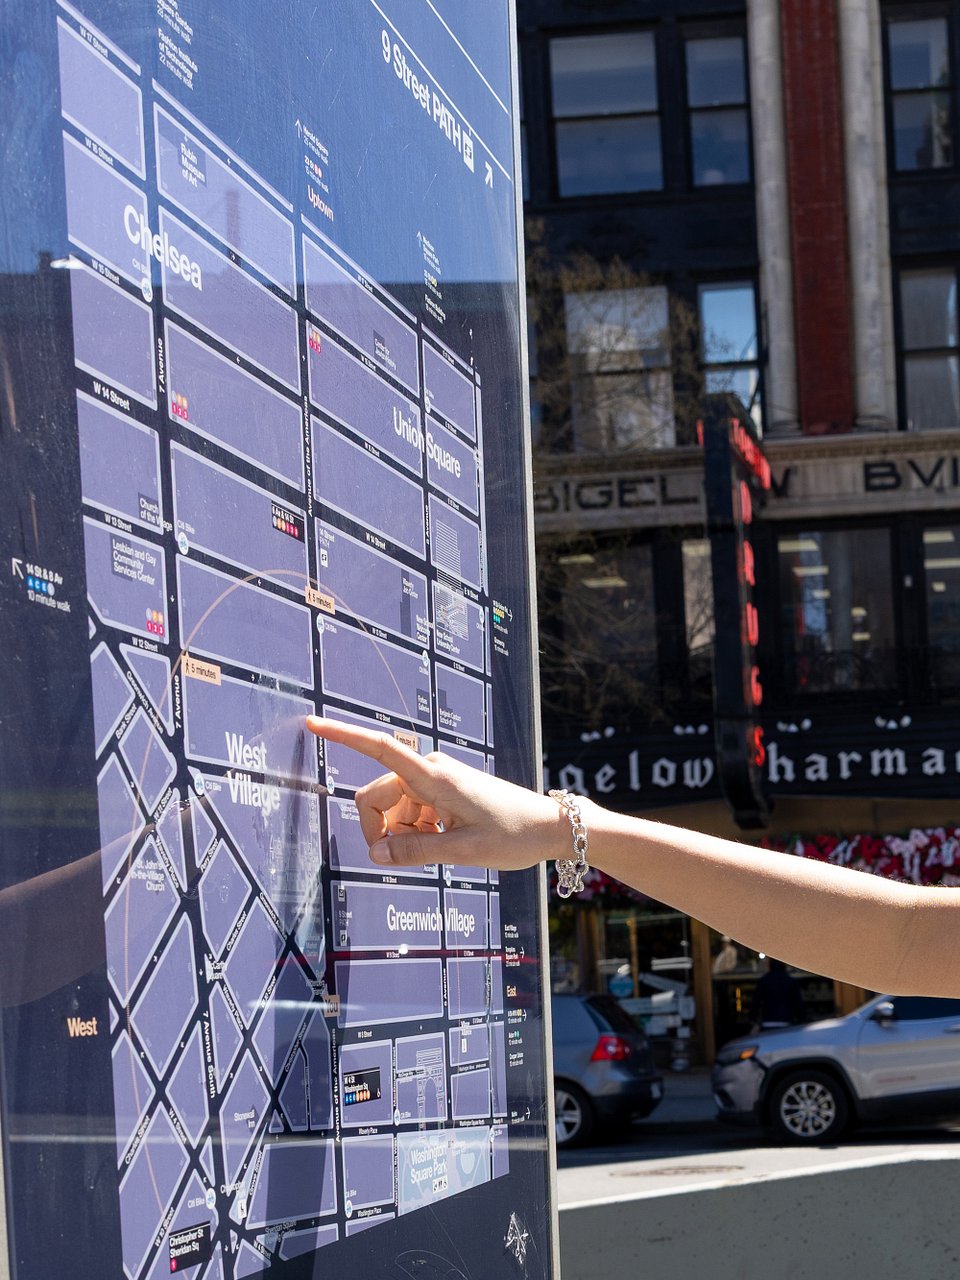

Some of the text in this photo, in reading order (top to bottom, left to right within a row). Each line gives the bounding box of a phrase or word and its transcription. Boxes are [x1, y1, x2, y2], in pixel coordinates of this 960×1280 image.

[381, 29, 461, 153] 9 Street PATH
[180, 142, 198, 165] Rubin
[181, 155, 206, 183] Museum
[188, 172, 198, 188] Art
[307, 184, 334, 222] Uptown
[123, 204, 203, 291] Chelsea
[157, 337, 165, 385] Avenue
[93, 381, 130, 411] W 14 Street
[393, 406, 461, 479] Union Square
[534, 466, 797, 513] BIGELW
[139, 497, 160, 514] Church
[146, 511, 156, 524] the
[117, 518, 132, 533] Street
[112, 539, 157, 567] Lesbian and Gay
[113, 552, 144, 572] Community
[113, 561, 155, 586] Services Center
[27, 589, 71, 613] 10 minute walk
[144, 640, 158, 653] Street
[196, 665, 217, 681] minutes
[126, 670, 164, 735] Greenwich Avenue
[174, 674, 182, 720] Avenue
[115, 703, 137, 740] Bank Street
[225, 731, 268, 771] West
[543, 749, 714, 797] igelow
[226, 770, 281, 818] Village
[200, 838, 219, 873] Perry Street
[145, 881, 165, 892] Church
[166, 864, 180, 889] Place
[236, 910, 247, 931] Street
[386, 903, 475, 938] Greenwich Village
[506, 984, 517, 997] East
[222, 983, 244, 1031] Waverly Place
[324, 998, 339, 1014] You
[67, 1017, 98, 1038] West
[203, 1021, 212, 1063] Avenue
[207, 1065, 216, 1099] South
[124, 1114, 150, 1164] Charles Street
[175, 1122, 188, 1145] Street
[410, 1142, 448, 1166] Washington
[410, 1158, 448, 1184] Square Park
[162, 1206, 175, 1230] Street
[169, 1231, 197, 1248] Christopher
[169, 1243, 191, 1258] Sheridan
